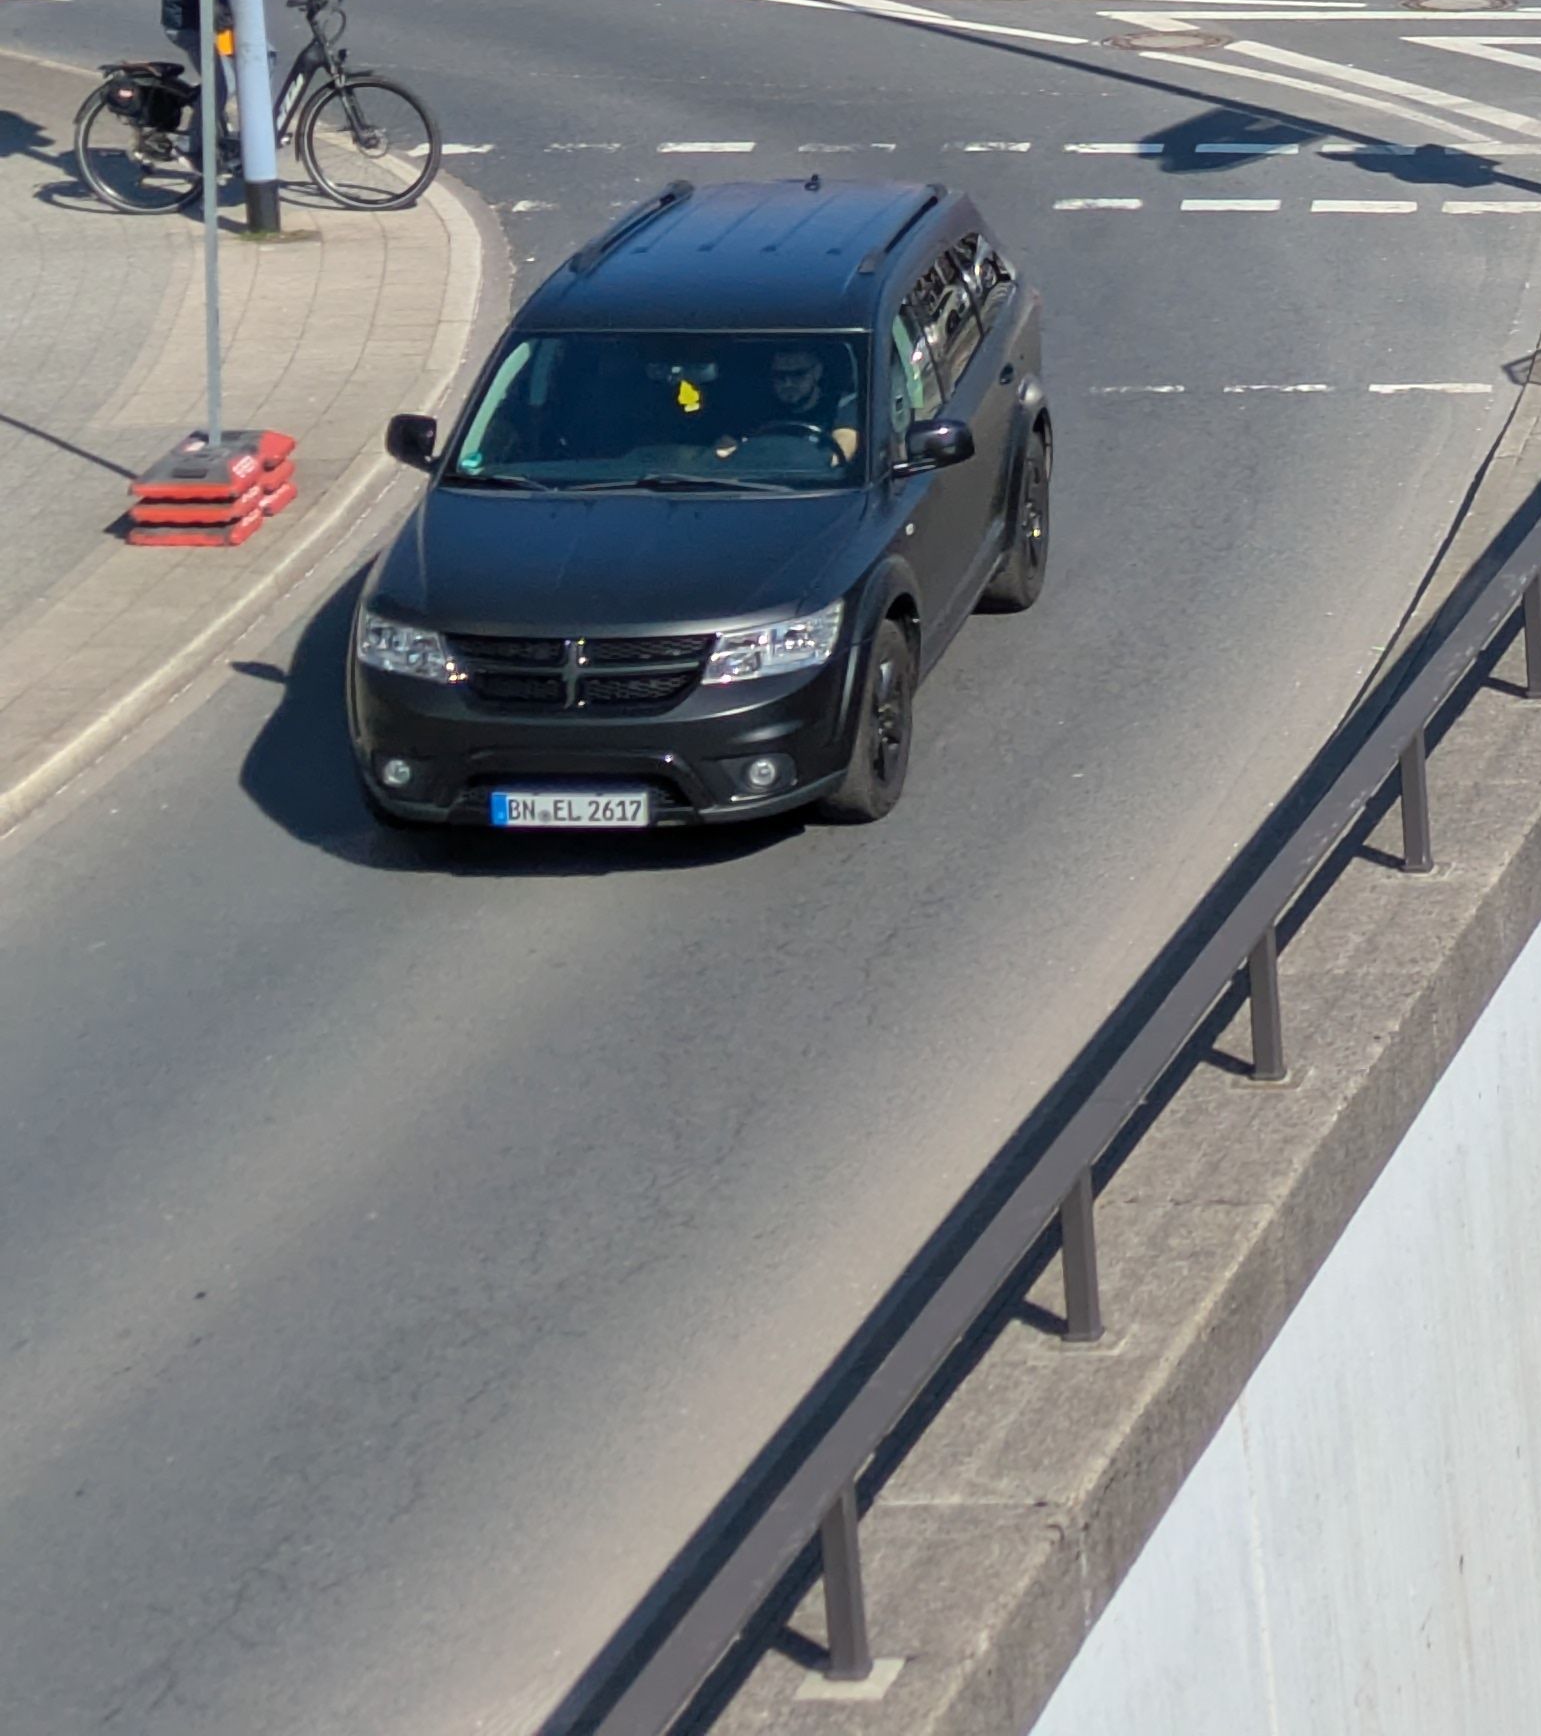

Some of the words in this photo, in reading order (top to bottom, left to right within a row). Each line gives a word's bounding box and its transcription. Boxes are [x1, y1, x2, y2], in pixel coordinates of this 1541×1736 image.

[508, 799, 535, 821] BN
[553, 799, 581, 821] EL
[588, 800, 642, 822] 2617
